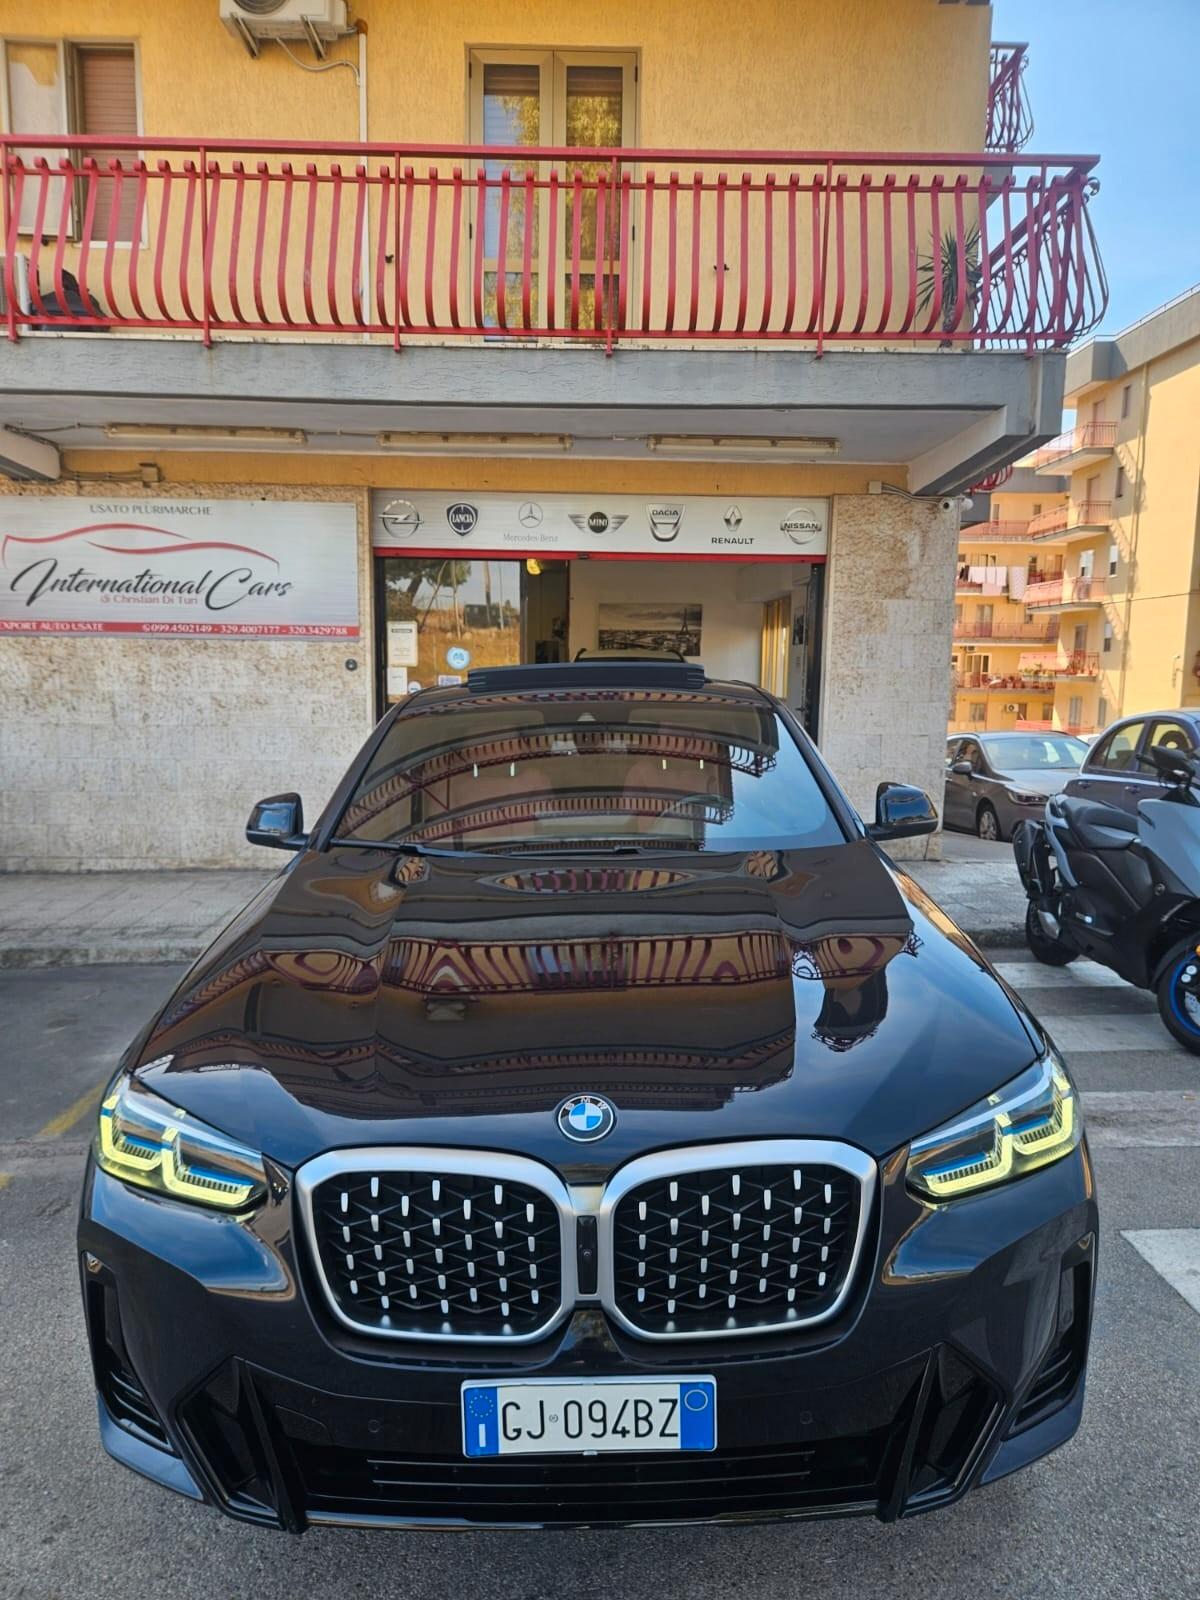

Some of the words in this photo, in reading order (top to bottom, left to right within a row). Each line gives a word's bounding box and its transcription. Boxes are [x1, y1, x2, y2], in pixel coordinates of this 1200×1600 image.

[89, 504, 129, 514] USATO
[132, 504, 214, 516] PLURIMARCHE
[651, 509, 679, 517] DACIA
[452, 513, 474, 524] LANCIA
[588, 518, 608, 528] MINI
[784, 521, 819, 530] NISSAN
[711, 537, 755, 545] RENAULT
[9, 557, 212, 607] International
[204, 567, 294, 611] Cars
